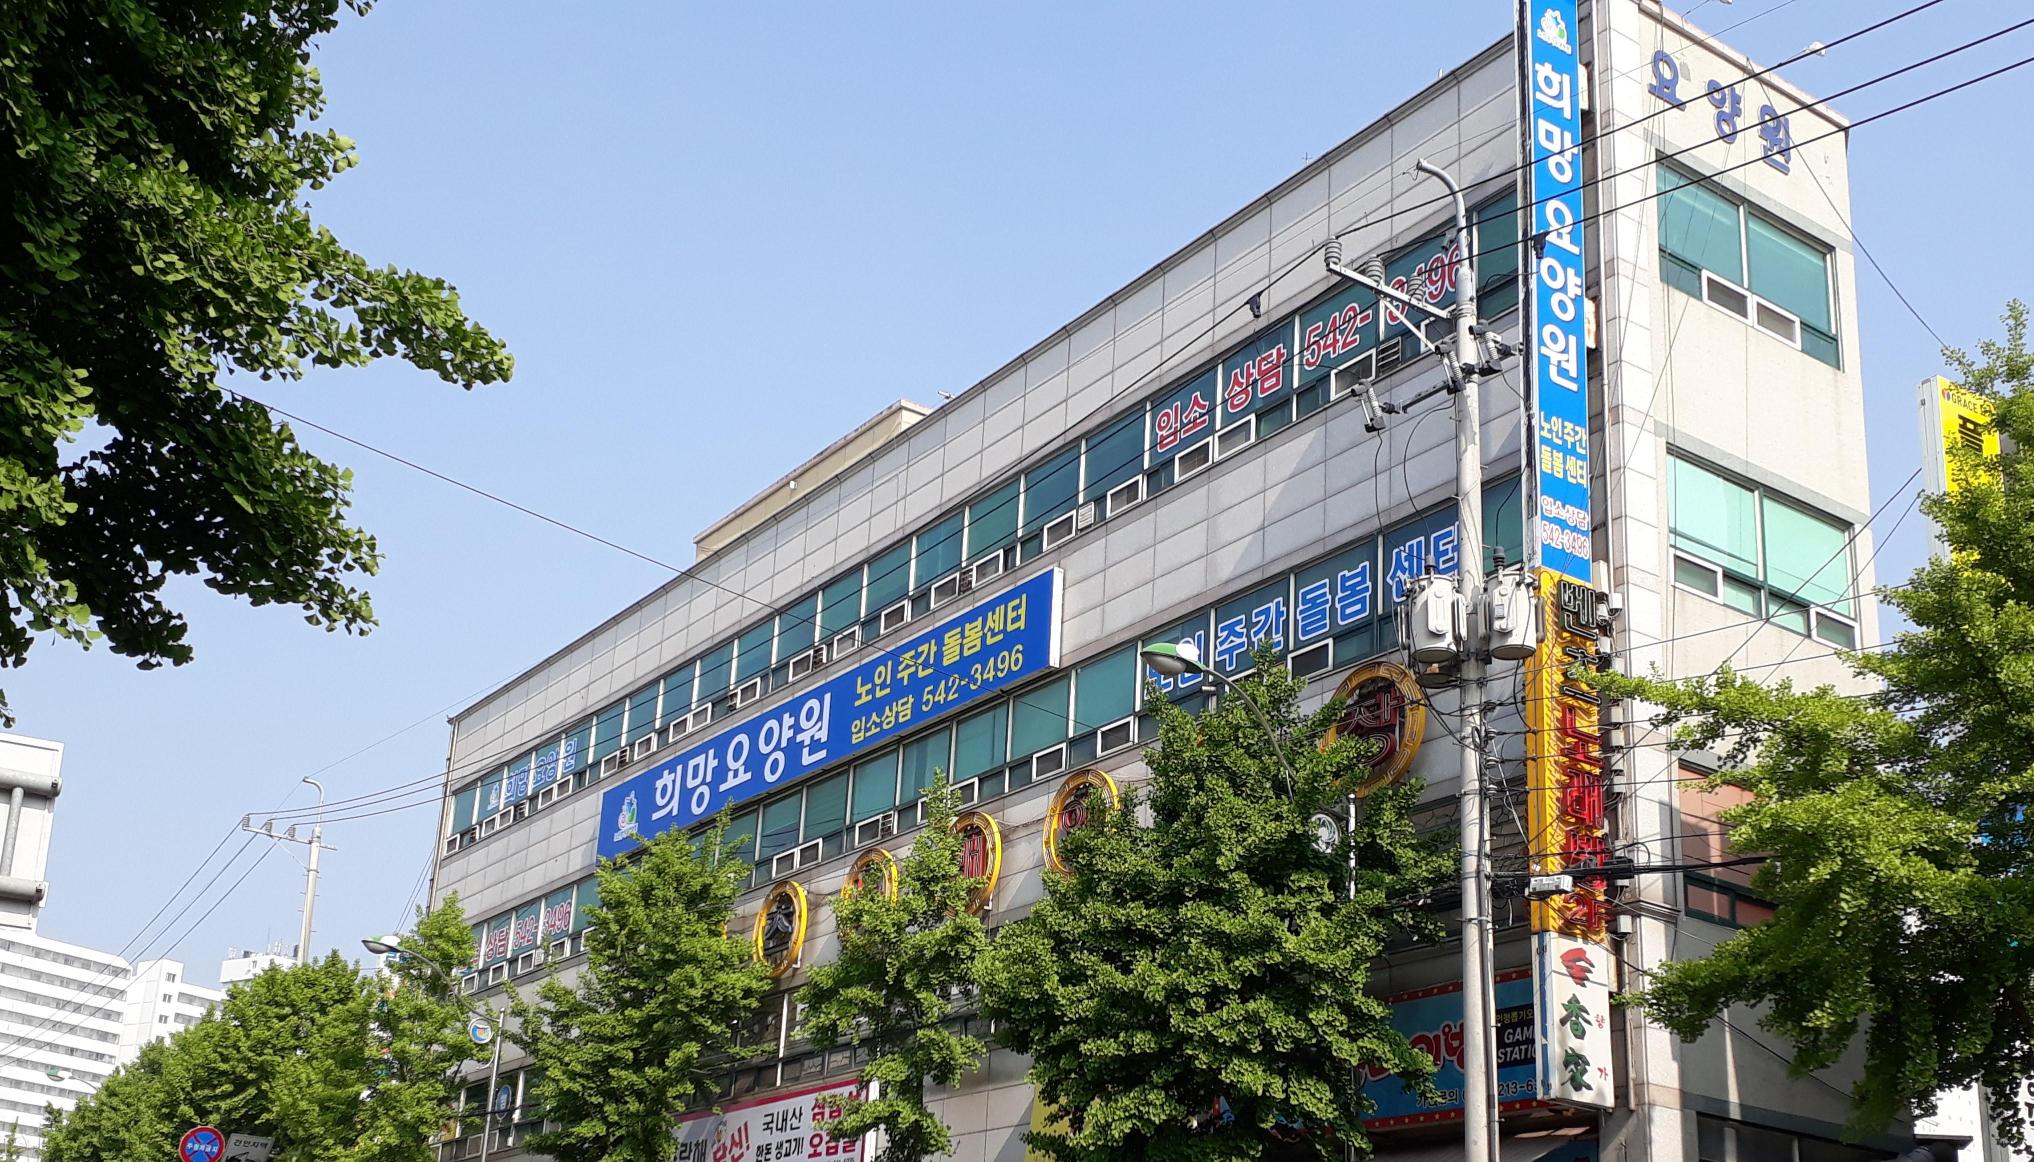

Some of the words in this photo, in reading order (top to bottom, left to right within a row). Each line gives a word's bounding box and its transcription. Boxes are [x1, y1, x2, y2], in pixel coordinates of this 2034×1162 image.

[1648, 50, 1791, 176] 요양원
[1535, 61, 1582, 392] 희망요양원
[1156, 392, 1209, 453] 입소
[1225, 344, 1287, 413] 상담
[1952, 393, 1978, 413] GRACE
[1541, 522, 1590, 560] 542-3496
[1216, 596, 1287, 672] 주간
[1297, 559, 1372, 641] 돌봄
[851, 694, 915, 745] 입소상담
[921, 643, 1024, 713] 542-3496
[854, 660, 892, 707] 노인
[897, 639, 938, 686] 주간
[651, 691, 832, 821] 희망요양원
[1504, 1025, 1536, 1043] GAM
[762, 1106, 803, 1136] 국내산
